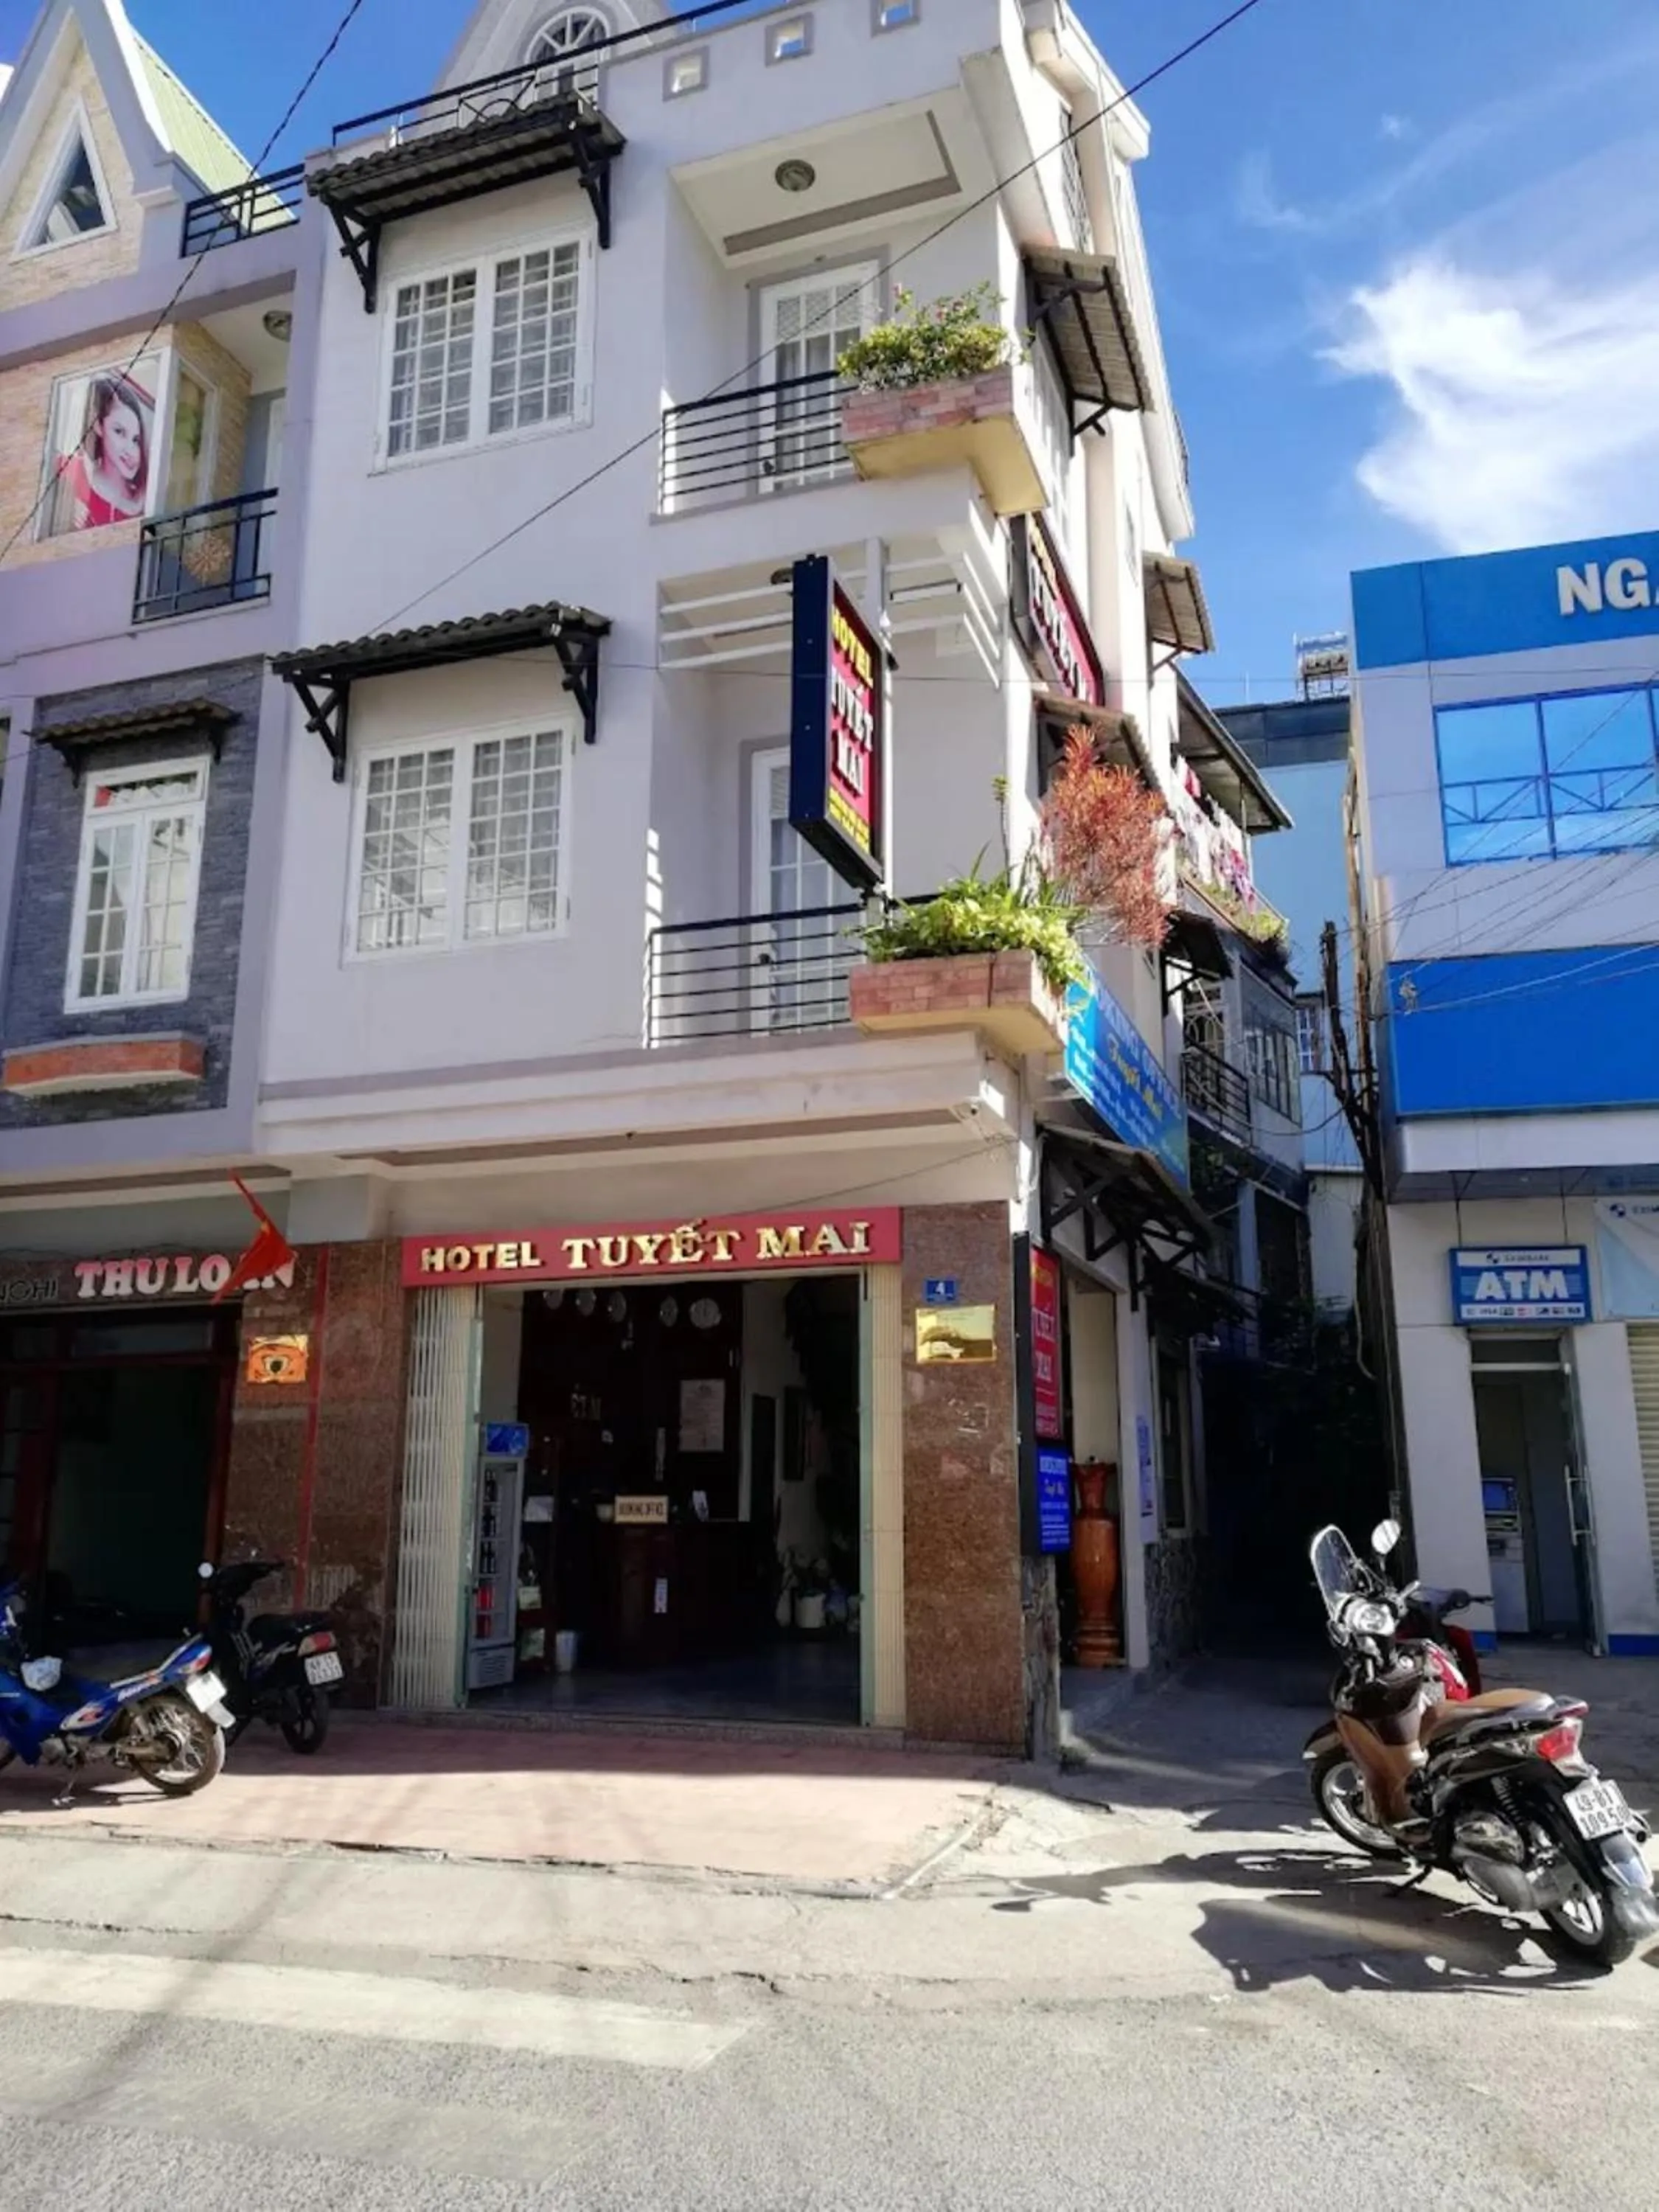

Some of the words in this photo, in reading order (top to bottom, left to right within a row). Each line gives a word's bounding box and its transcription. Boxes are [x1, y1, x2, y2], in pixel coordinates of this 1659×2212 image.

[1557, 557, 1659, 616] NG
[832, 605, 874, 689] HOTEL
[837, 731, 864, 796] MAI
[421, 1242, 542, 1273] HOTEL
[561, 1218, 742, 1269] TUYẾT
[755, 1221, 872, 1259] MAI
[74, 1257, 169, 1298] THU
[173, 1254, 295, 1293] LON
[934, 1281, 946, 1295] 4
[1475, 1268, 1570, 1300] ATM
